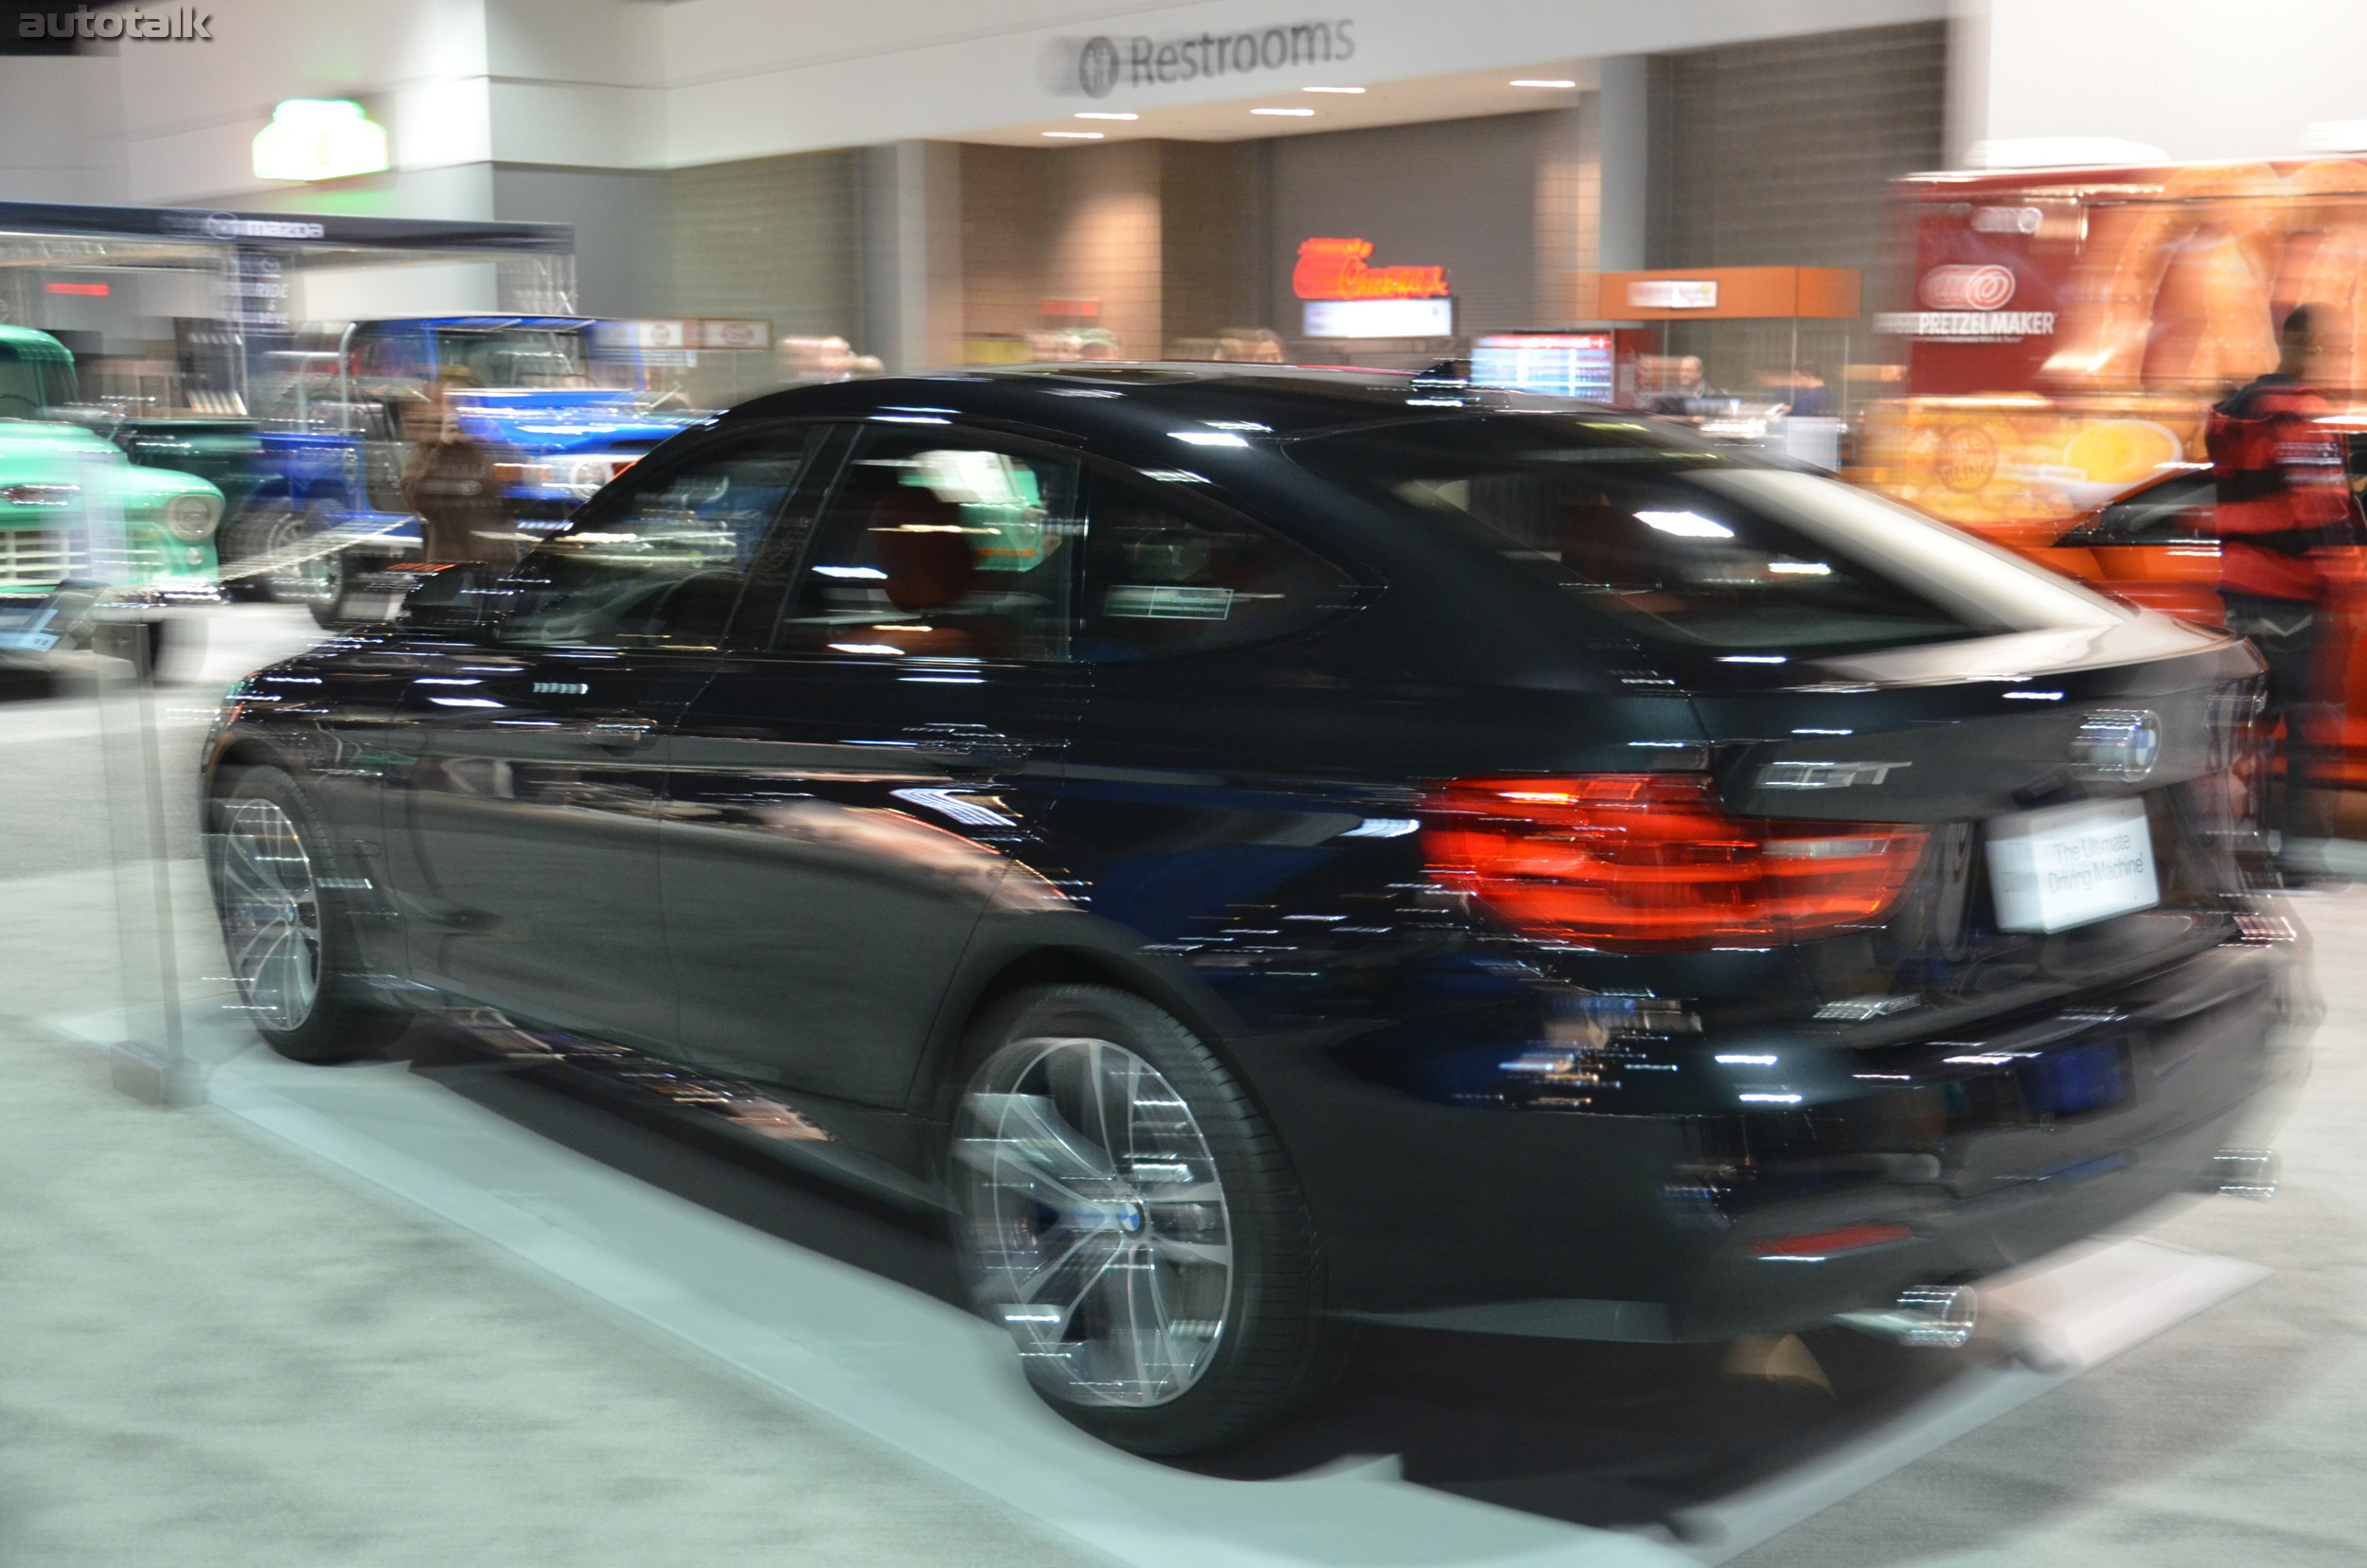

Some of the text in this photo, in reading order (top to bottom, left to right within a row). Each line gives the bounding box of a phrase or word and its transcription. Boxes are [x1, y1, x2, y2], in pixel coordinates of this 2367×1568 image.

[1131, 19, 1355, 87] Restrooms
[255, 283, 289, 297] RIDE
[1918, 312, 2054, 334] PRETZELMAKER
[2053, 833, 2130, 864] The Ultimate
[2048, 865, 2092, 893] Driving
